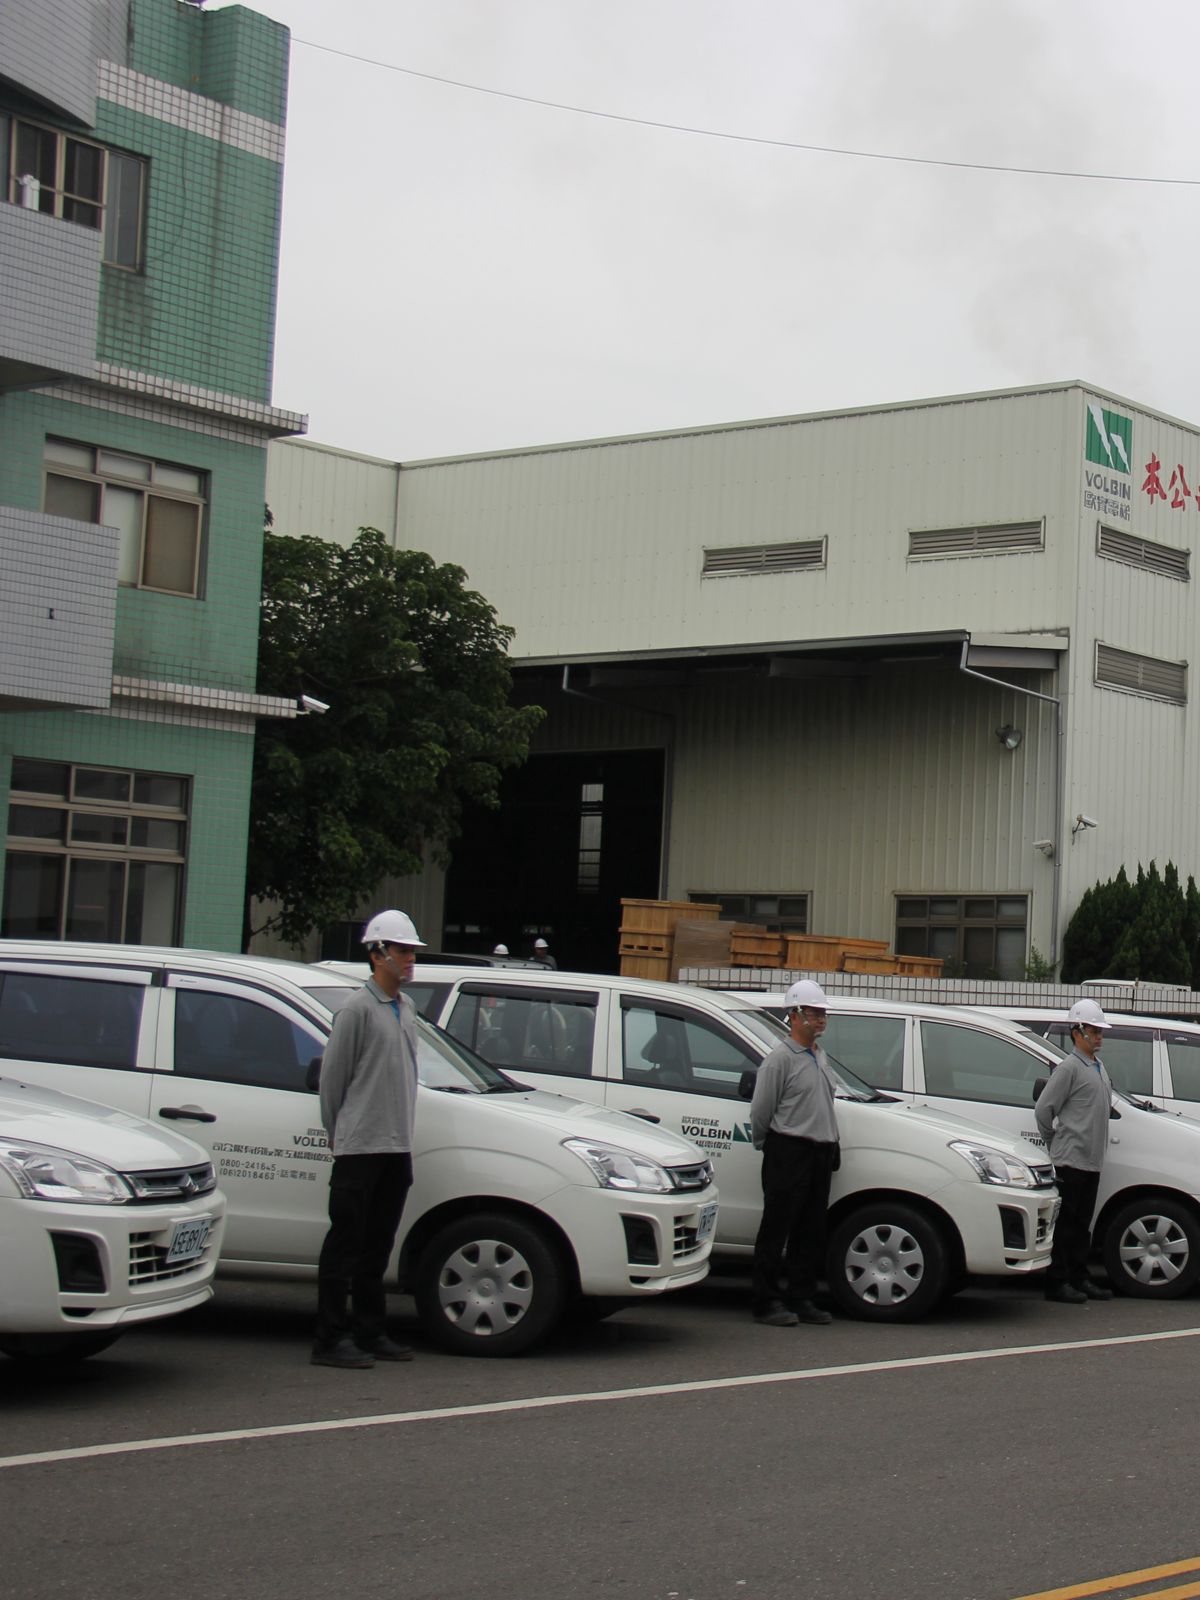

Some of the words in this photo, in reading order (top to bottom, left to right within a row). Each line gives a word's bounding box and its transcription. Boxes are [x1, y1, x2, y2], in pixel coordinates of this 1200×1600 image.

[1085, 470, 1131, 501] VOLBIN
[681, 1125, 732, 1140] VOLBIN
[293, 1135, 329, 1148] VOLB
